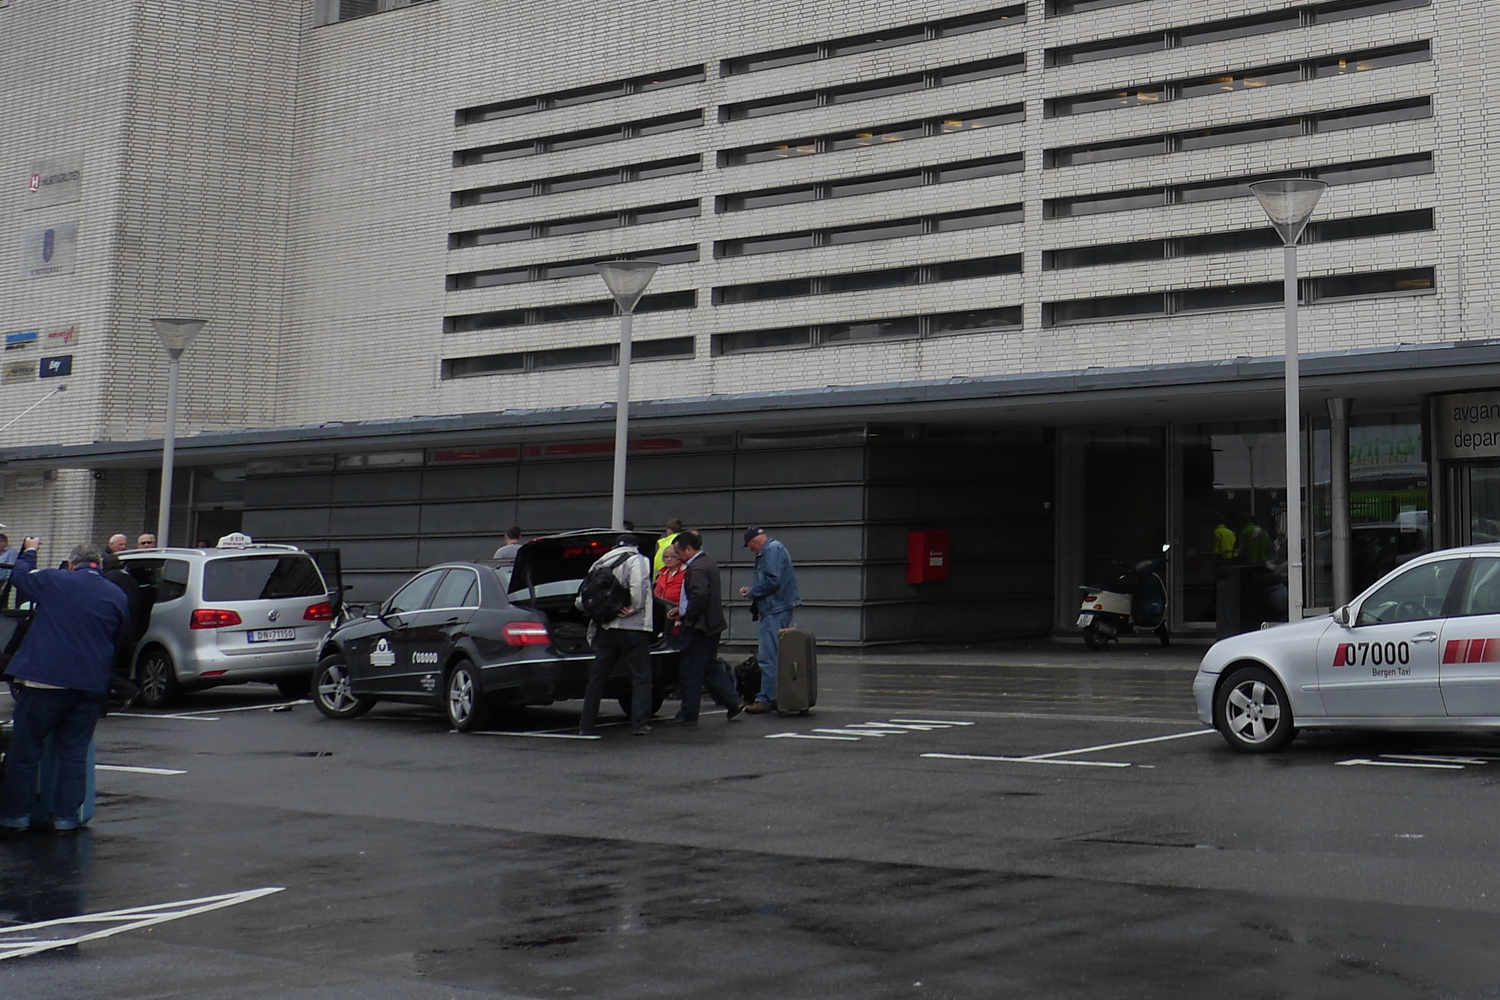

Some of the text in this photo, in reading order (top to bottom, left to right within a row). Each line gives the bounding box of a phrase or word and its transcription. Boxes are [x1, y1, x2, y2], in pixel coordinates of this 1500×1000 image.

[1345, 642, 1410, 666] 07000
[1372, 667, 1411, 679] Bergen Taxi
